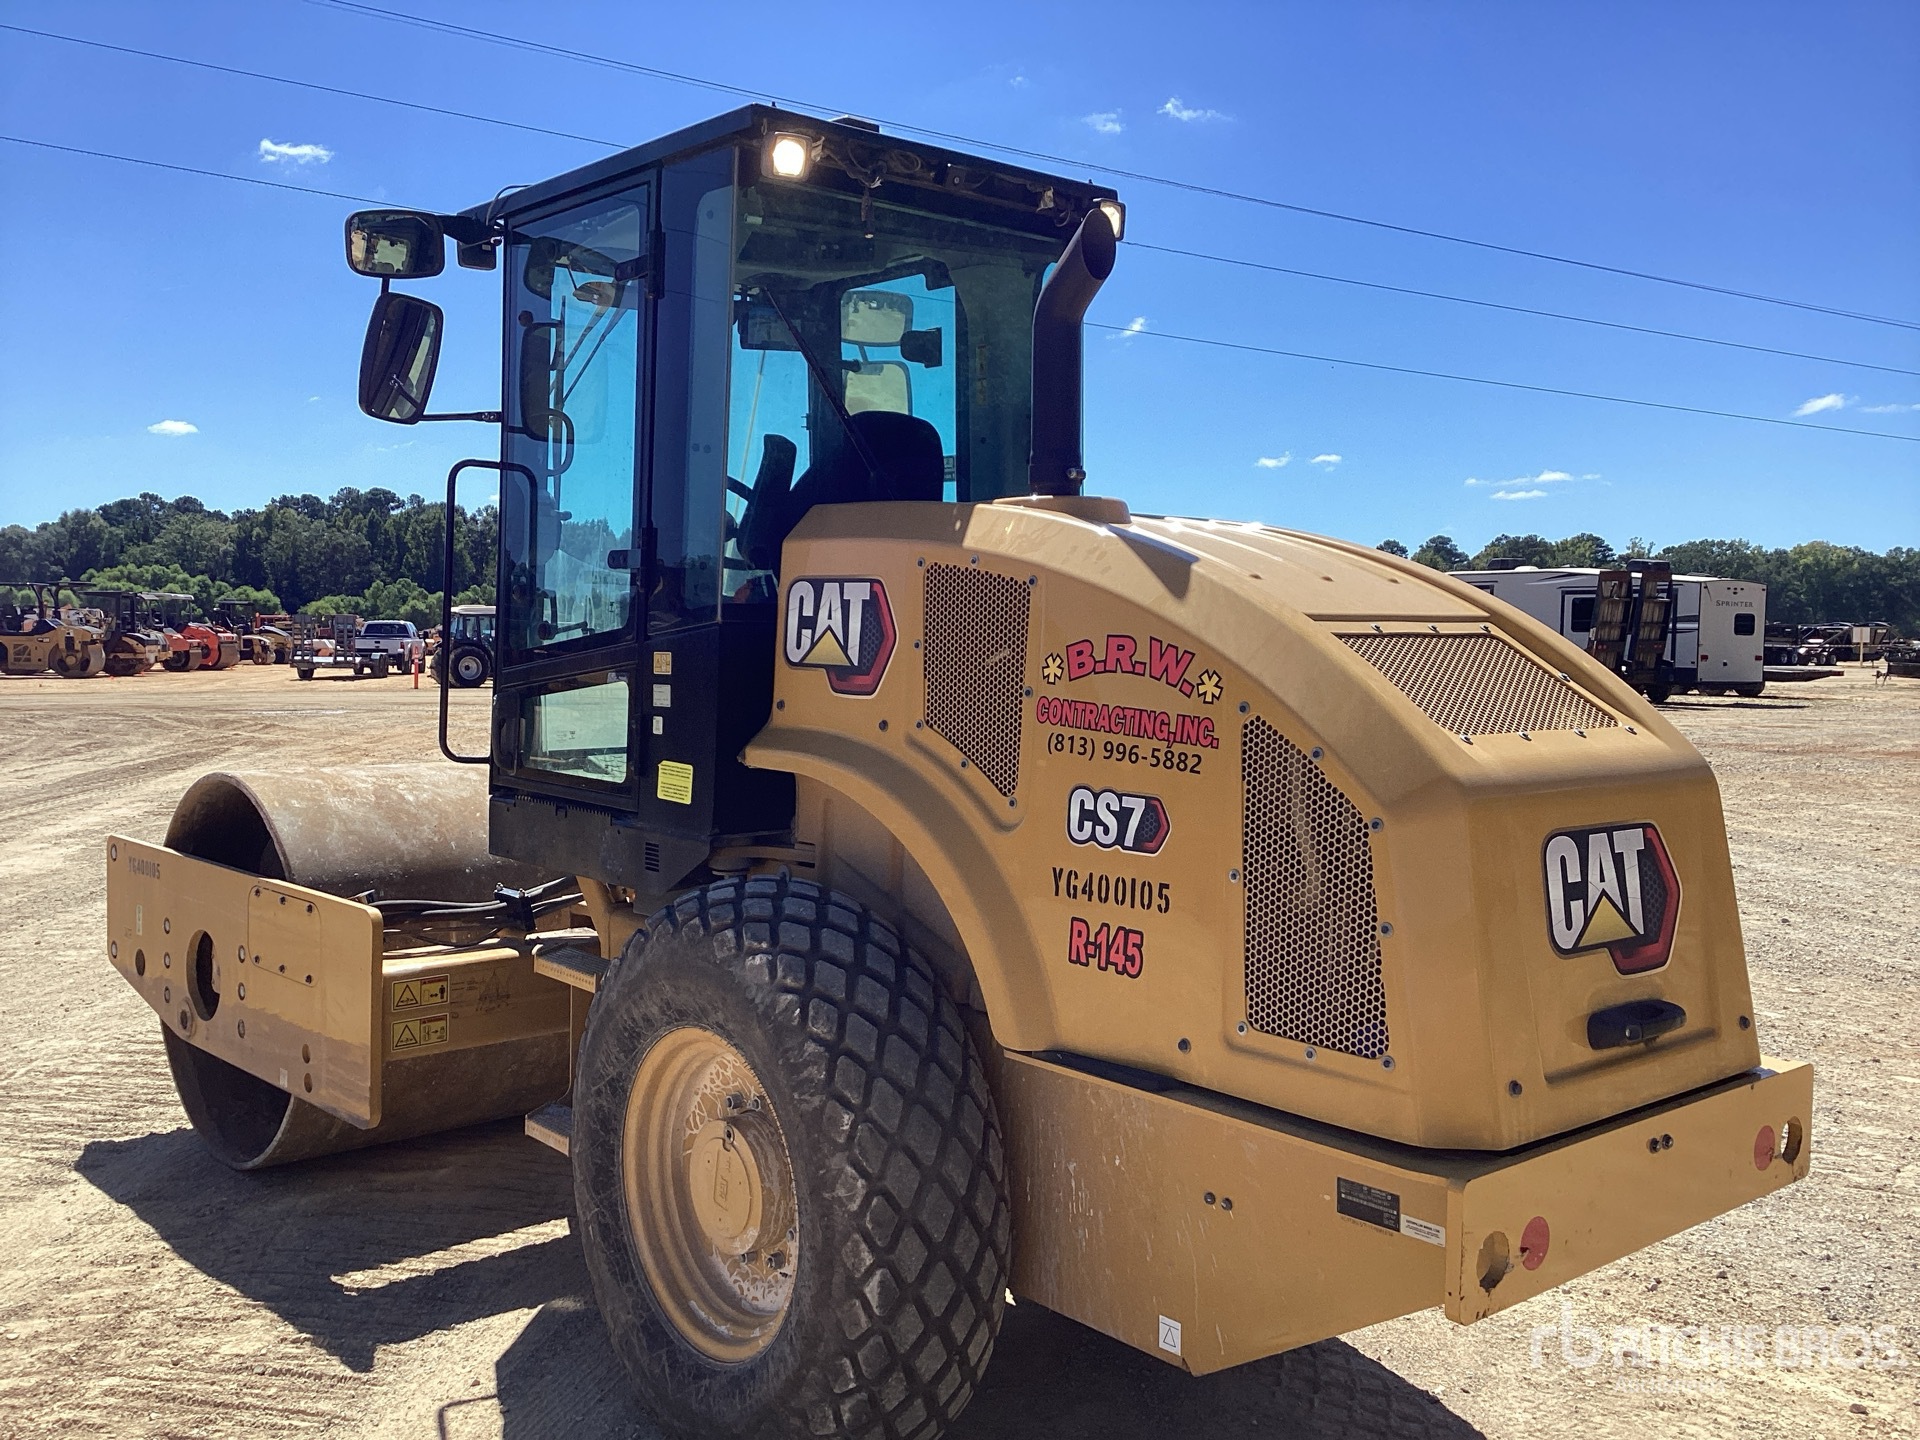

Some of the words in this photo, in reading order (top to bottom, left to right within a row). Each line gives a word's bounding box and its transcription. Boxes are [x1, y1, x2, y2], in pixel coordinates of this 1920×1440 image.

[786, 580, 871, 667] CAT
[1066, 634, 1196, 698] B.R.W.
[1047, 732, 1096, 762] (813)
[1103, 740, 1203, 775] 996-5882
[1069, 785, 1147, 849] CS7
[1545, 827, 1646, 950] CAT
[1068, 916, 1144, 979] R-145
